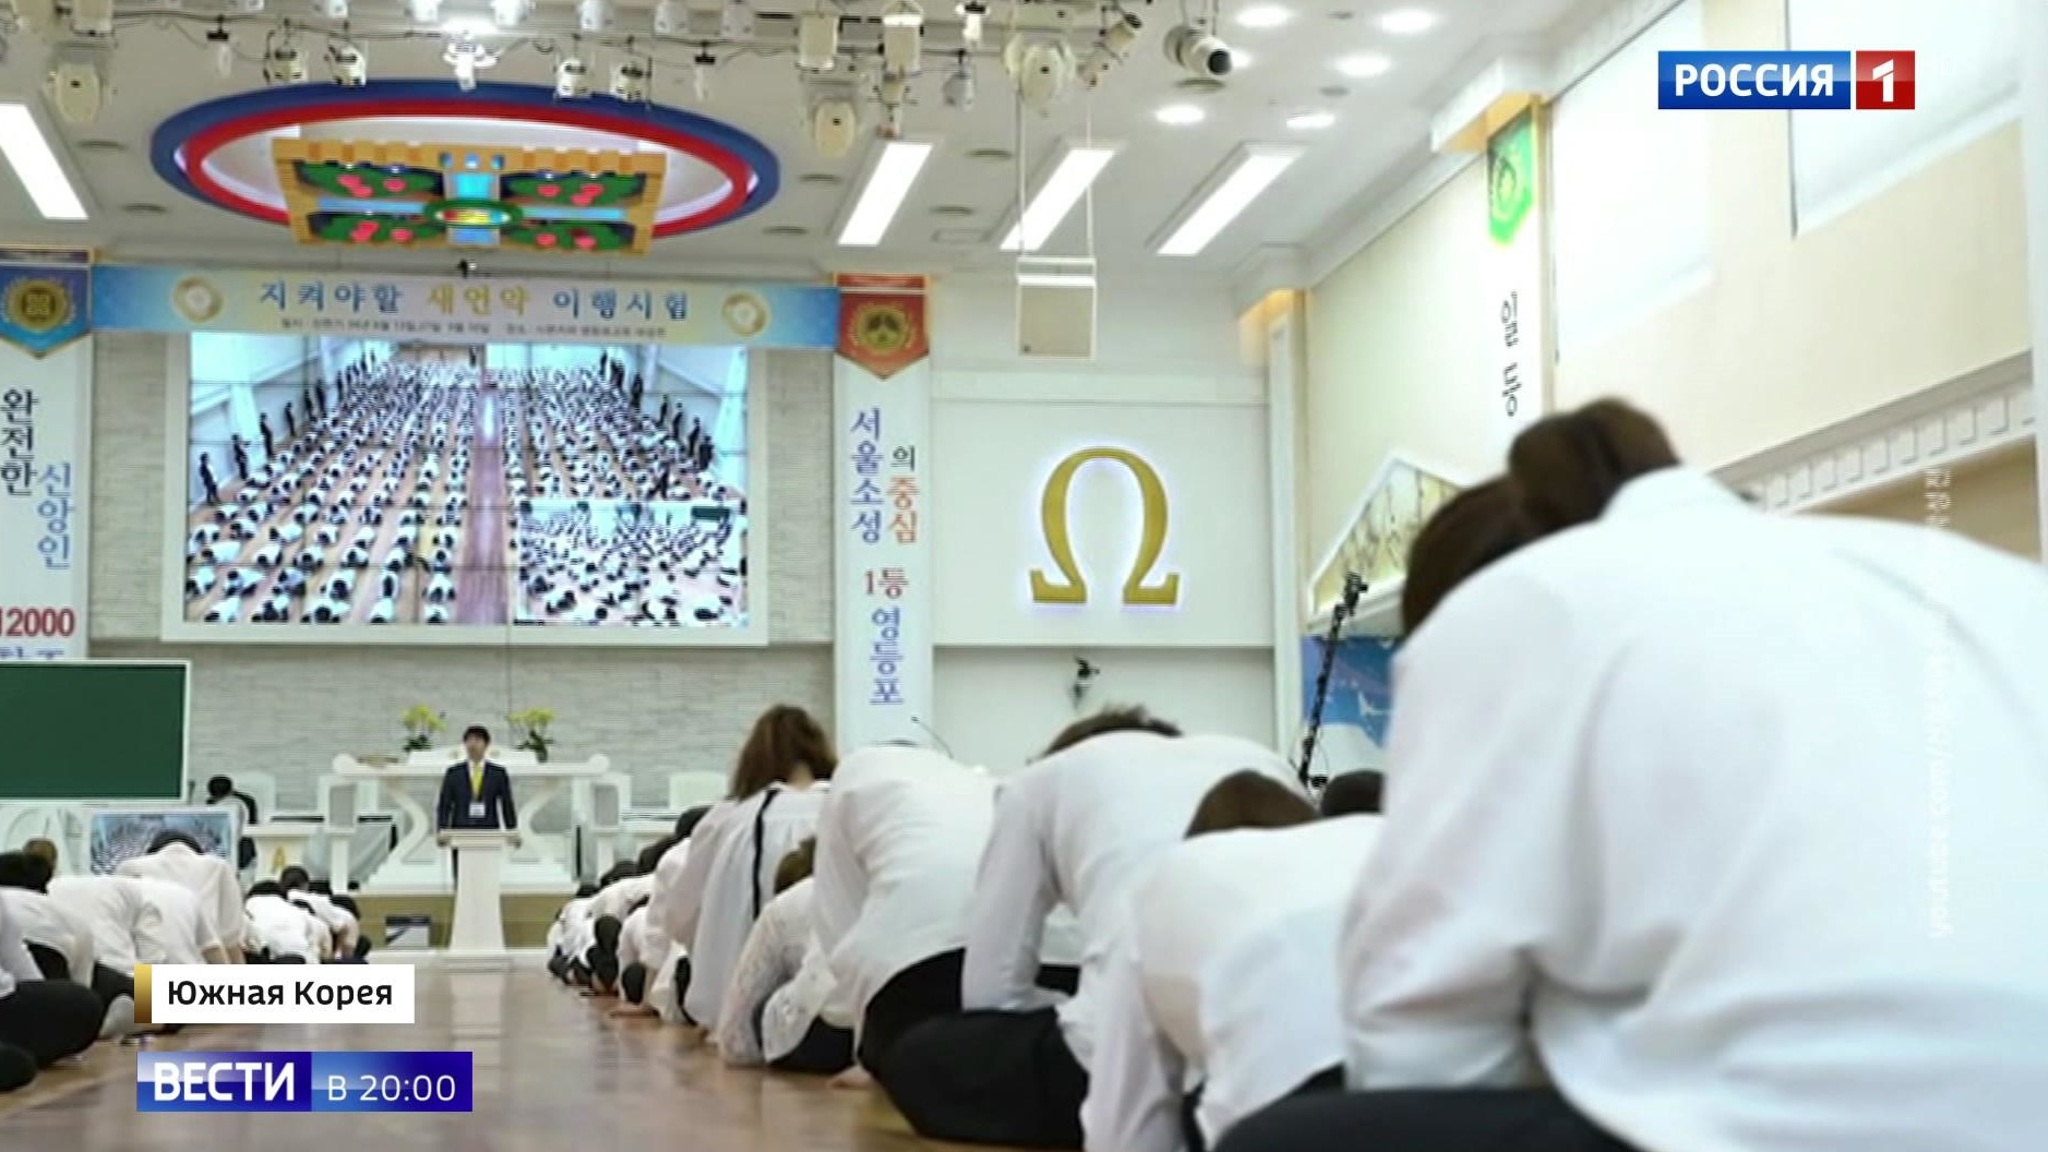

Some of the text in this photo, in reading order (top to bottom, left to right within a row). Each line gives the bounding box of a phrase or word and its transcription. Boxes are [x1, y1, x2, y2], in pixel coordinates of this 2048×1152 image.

[259, 279, 688, 321] 지켜야할 새언약 이행시험
[1, 387, 40, 496] 완전한
[850, 407, 885, 546] 서울소성
[37, 462, 77, 570] 신앙인
[864, 567, 910, 600] 1등
[869, 605, 905, 706] 영등포
